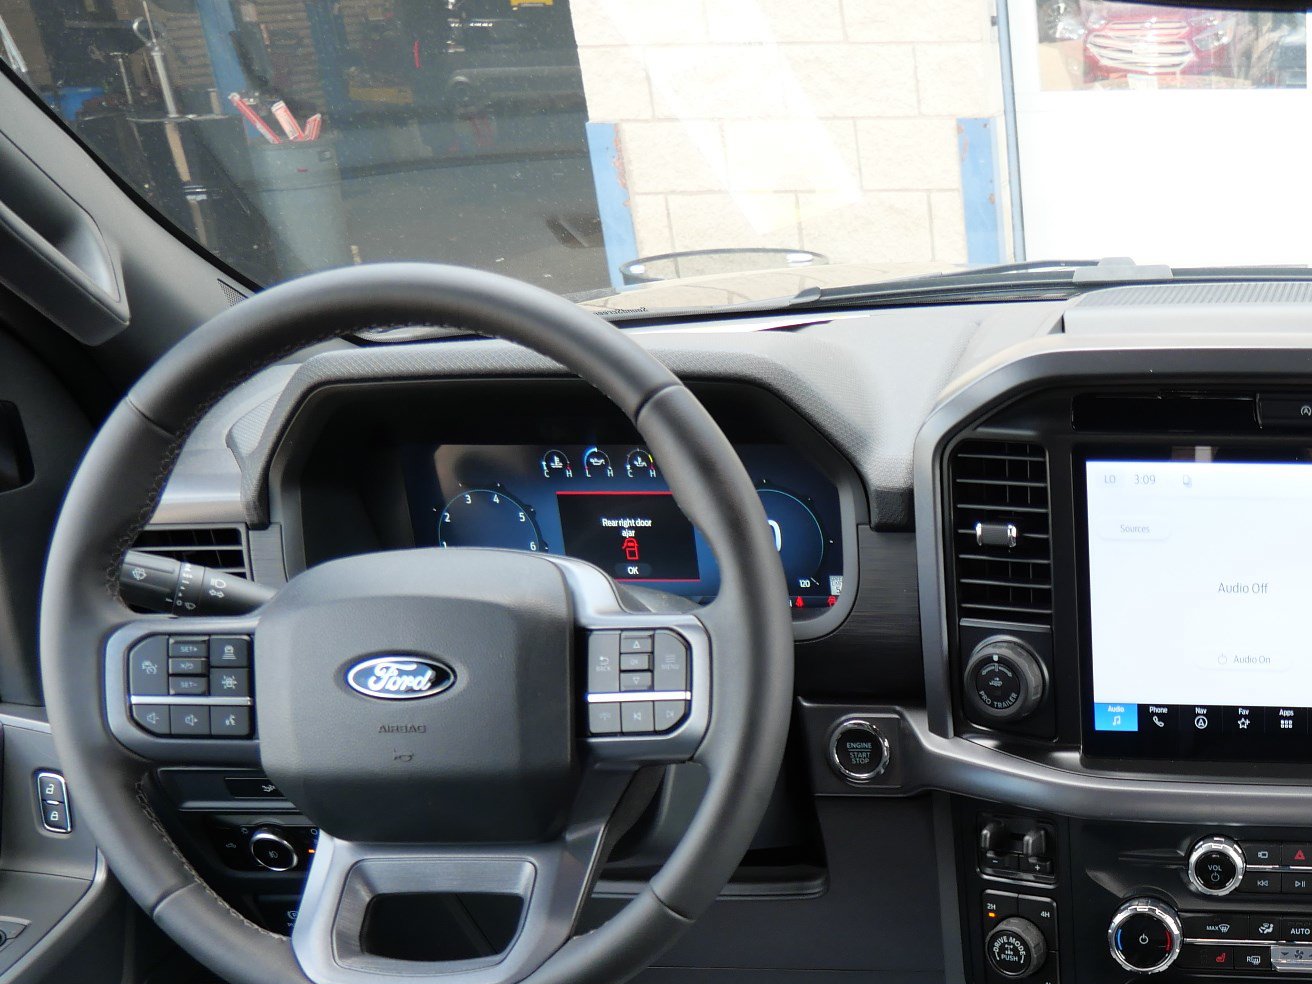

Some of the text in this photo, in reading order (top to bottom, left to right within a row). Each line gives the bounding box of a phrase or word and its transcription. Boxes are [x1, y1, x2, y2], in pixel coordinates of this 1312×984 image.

[544, 470, 550, 478] C
[566, 470, 573, 478] H
[1135, 474, 1156, 485] 3:09
[465, 494, 472, 504] 3
[493, 494, 500, 504] 4
[444, 512, 451, 523] 2
[519, 512, 525, 522] 5
[602, 518, 652, 528] Rear right door
[1120, 524, 1150, 533] Sources
[622, 530, 635, 538] ajar
[530, 542, 536, 551] 6
[627, 566, 639, 575] OK
[799, 579, 811, 588] 120
[1218, 582, 1269, 594] Audio Off
[1233, 655, 1271, 664] Audio On
[368, 662, 435, 691] Ford
[978, 690, 1018, 709] PRO TRAILER
[1107, 705, 1125, 713] Audio
[1149, 706, 1168, 714] Phone
[1195, 707, 1207, 715] Nav
[1238, 707, 1250, 715] Fav
[1278, 708, 1294, 717] Apps
[378, 725, 427, 734] AIRBAG
[849, 751, 870, 759] START
[851, 757, 870, 765] STOP
[1208, 864, 1222, 872] VOL
[986, 902, 996, 911] 2H
[1040, 910, 1050, 918] 4H
[993, 935, 1026, 956] DRIVE MODE
[1001, 954, 1019, 962] PUSH
